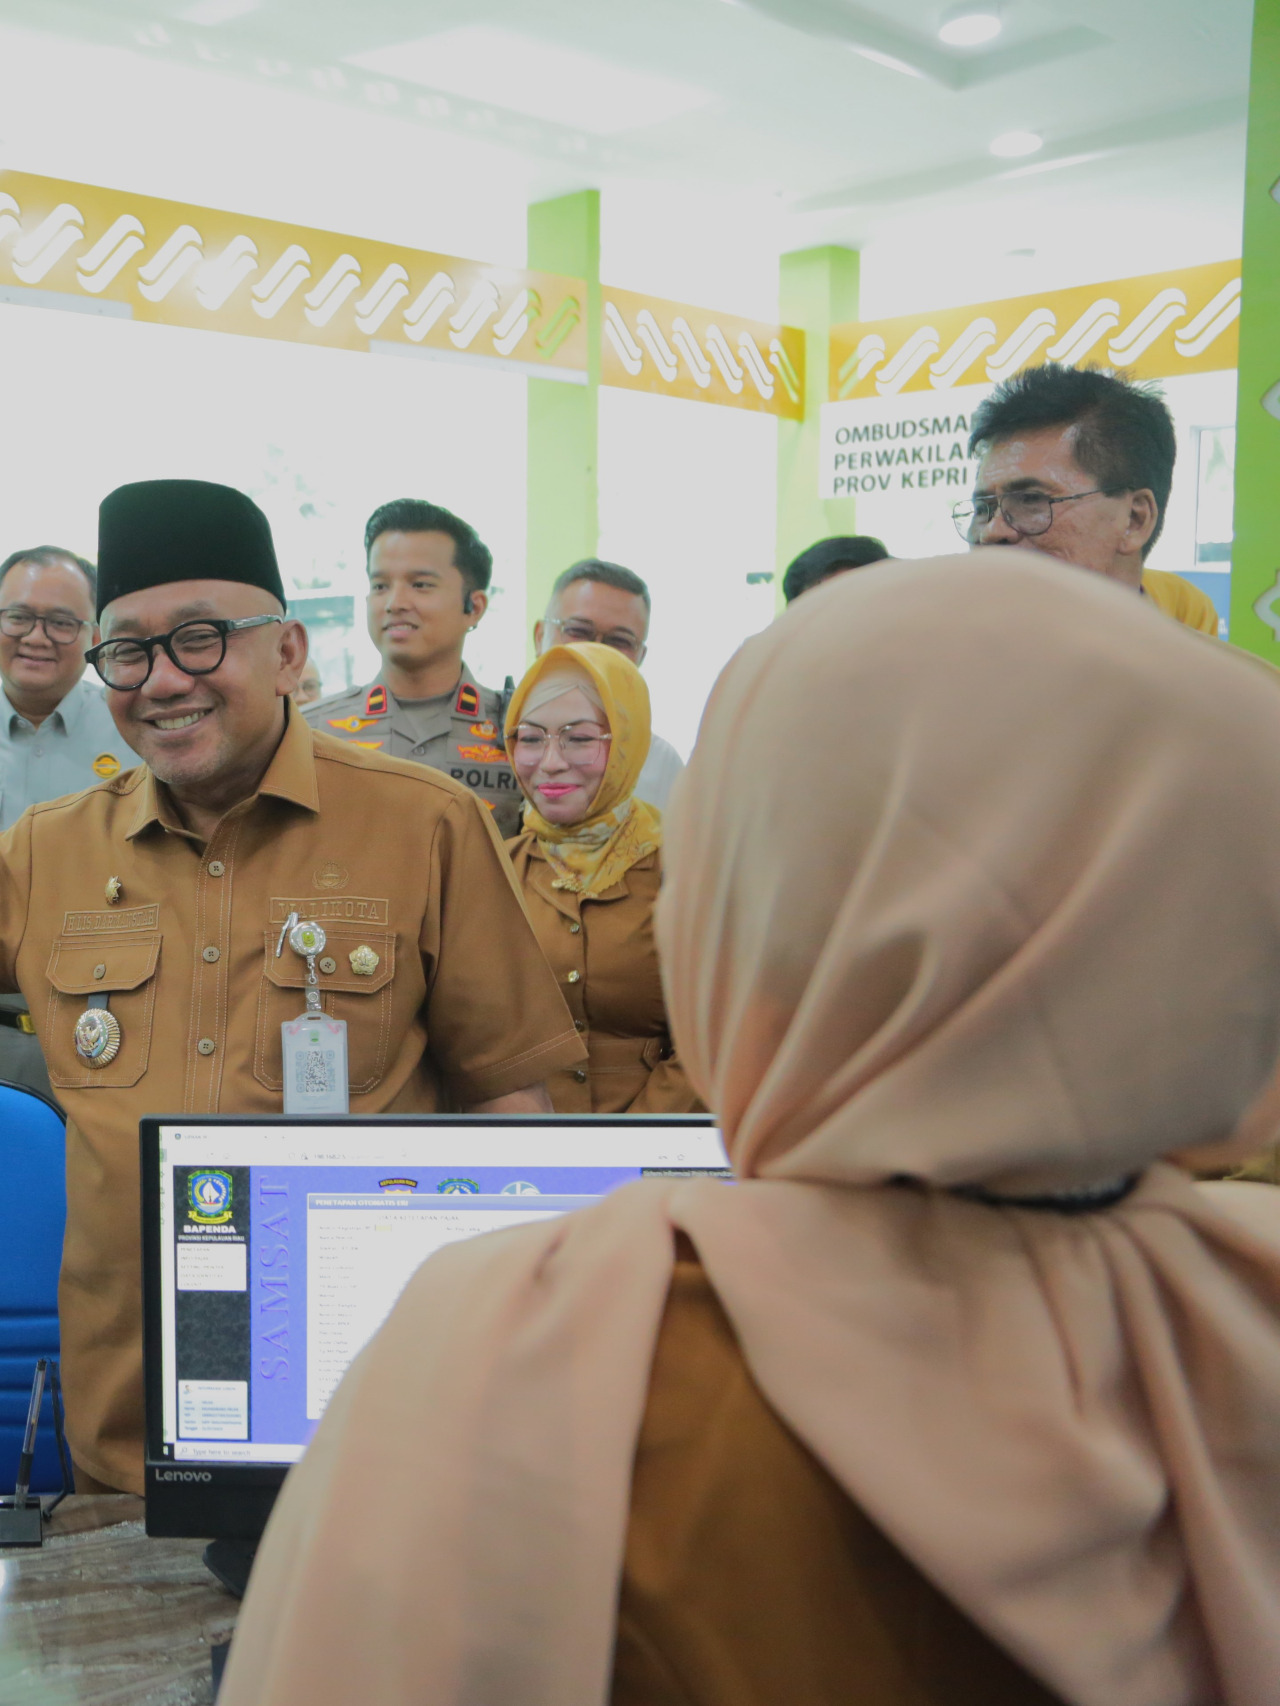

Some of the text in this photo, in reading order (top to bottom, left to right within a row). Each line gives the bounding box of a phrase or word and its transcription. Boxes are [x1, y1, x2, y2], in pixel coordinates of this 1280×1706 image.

[835, 413, 970, 446] OMBUDSMA
[834, 441, 972, 471] PERWAKILA
[833, 466, 968, 495] PROV KEPRI
[278, 901, 380, 920] WALIKOTA
[183, 1224, 237, 1234] BAPENDA
[259, 1175, 290, 1383] SAMSAT
[155, 1468, 212, 1482] Lenovo
